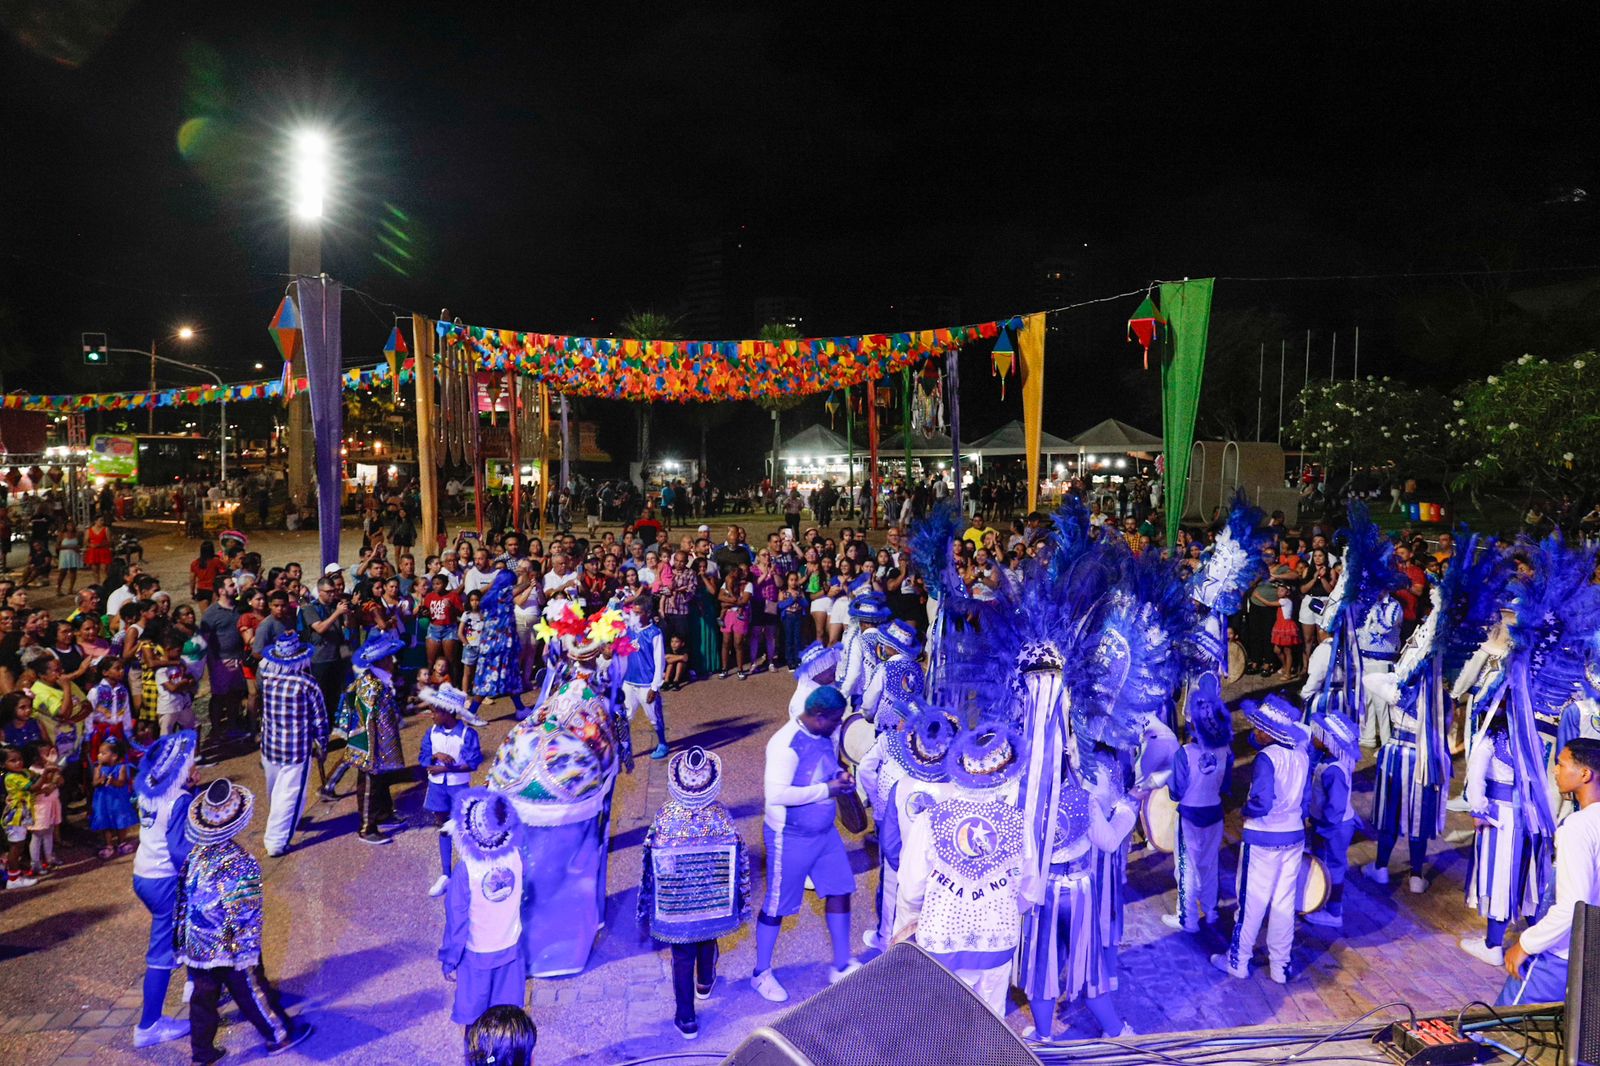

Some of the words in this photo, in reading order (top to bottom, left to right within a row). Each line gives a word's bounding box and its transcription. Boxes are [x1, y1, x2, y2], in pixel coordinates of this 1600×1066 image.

[931, 869, 963, 898] TRELA
[972, 888, 985, 901] DA
[989, 867, 1021, 891] NOTE
